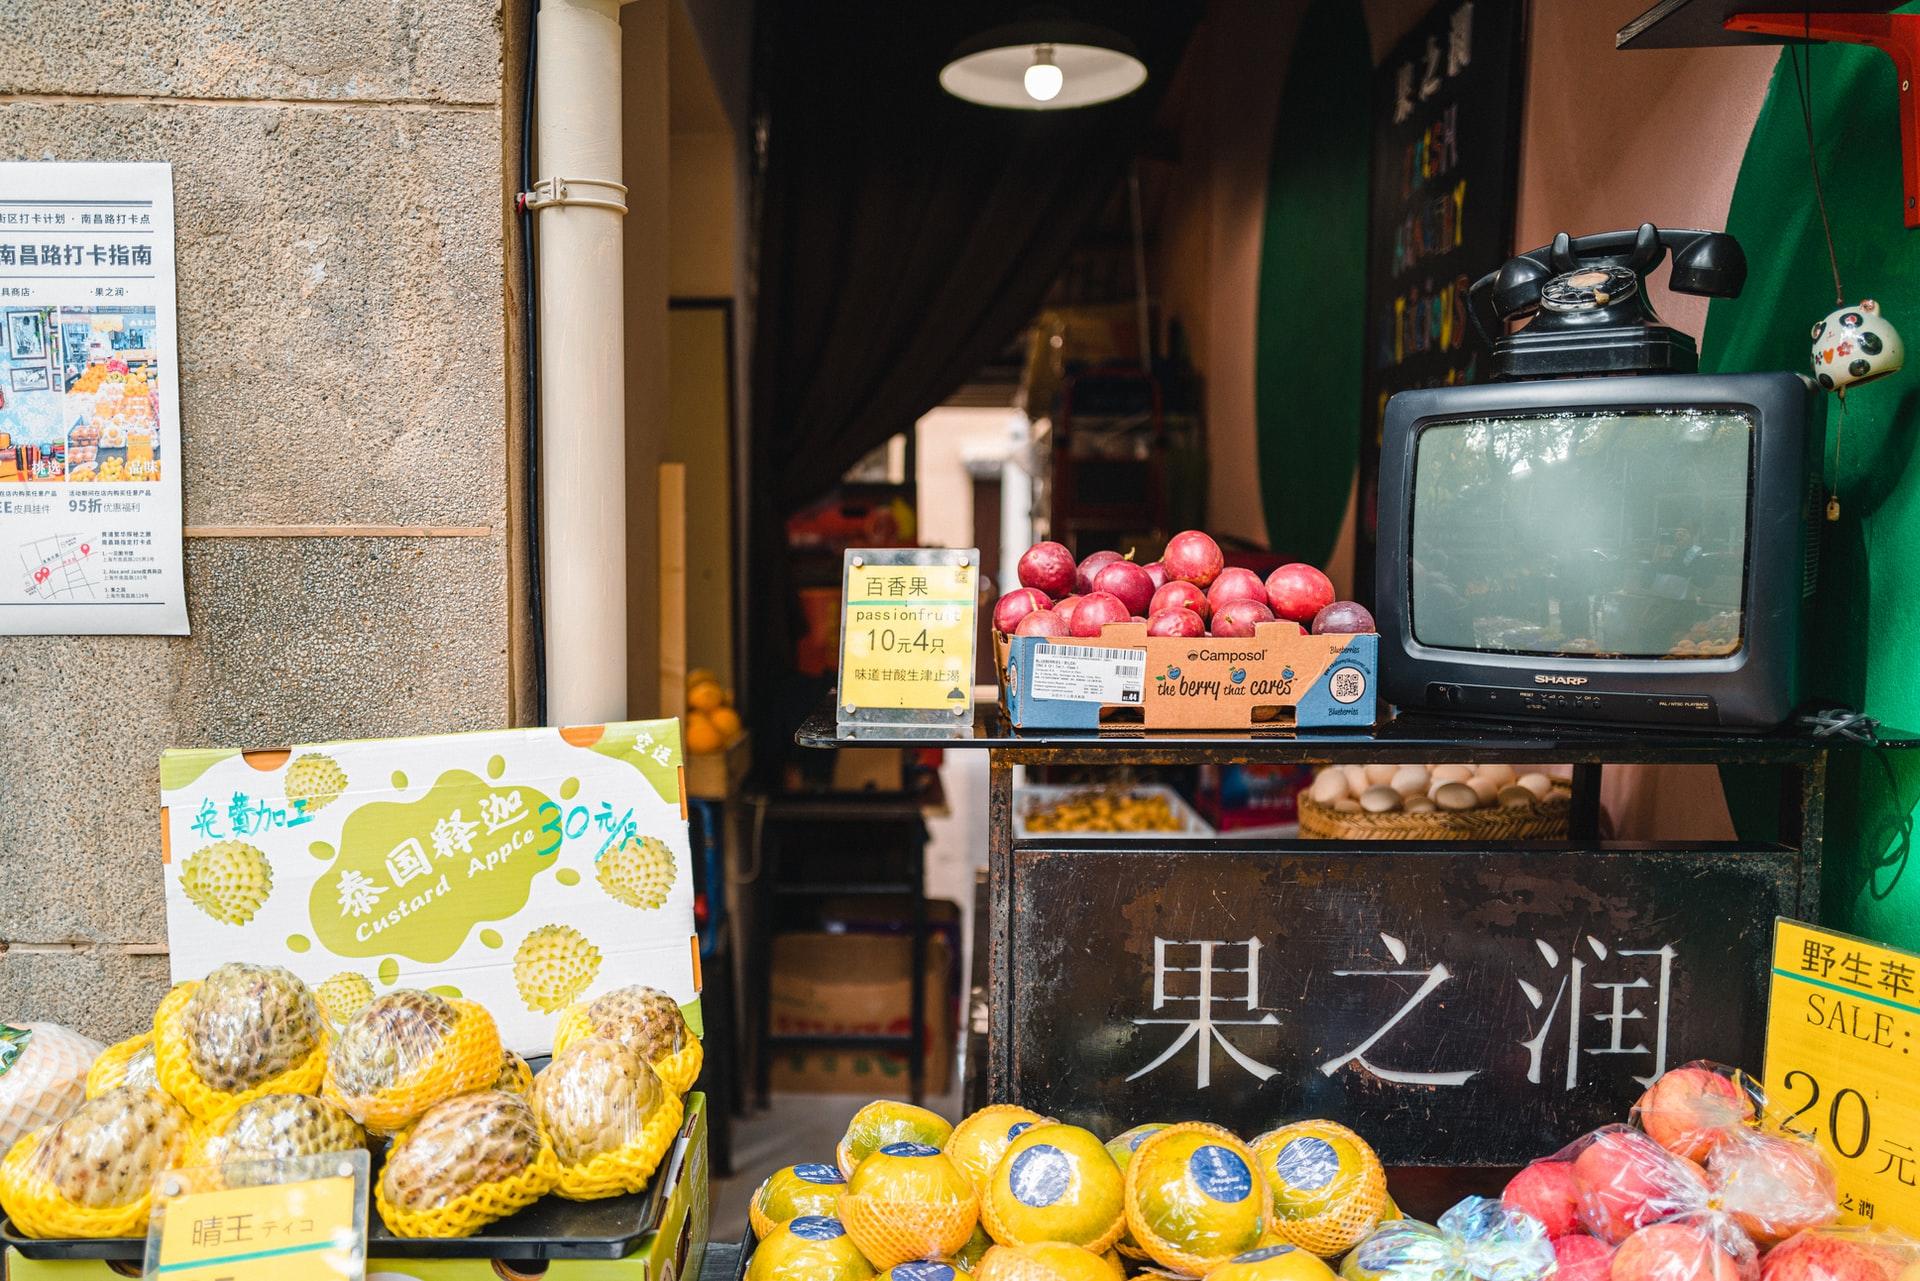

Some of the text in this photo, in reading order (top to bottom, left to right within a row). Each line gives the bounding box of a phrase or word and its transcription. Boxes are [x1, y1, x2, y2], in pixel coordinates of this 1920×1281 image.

[81, 213, 151, 225] 南昌路打卡点
[0, 244, 152, 266] 南昌路打卡指南
[866, 576, 928, 597] 百香果
[856, 608, 960, 623] passionfrut
[867, 628, 945, 654] 10元4只
[1200, 649, 1265, 663] Camposol
[855, 668, 960, 682] 味道甘酸生津止渴
[1534, 674, 1588, 685] SHARP
[1157, 681, 1176, 696] the
[1180, 676, 1220, 700] berry
[1224, 684, 1246, 695] that
[1250, 680, 1292, 695] cares
[336, 790, 529, 918] 泰国释迦
[356, 829, 535, 942] Custard Apple
[1125, 931, 1680, 1090] 果之润
[191, 1213, 315, 1249] 晴王 ティコ
